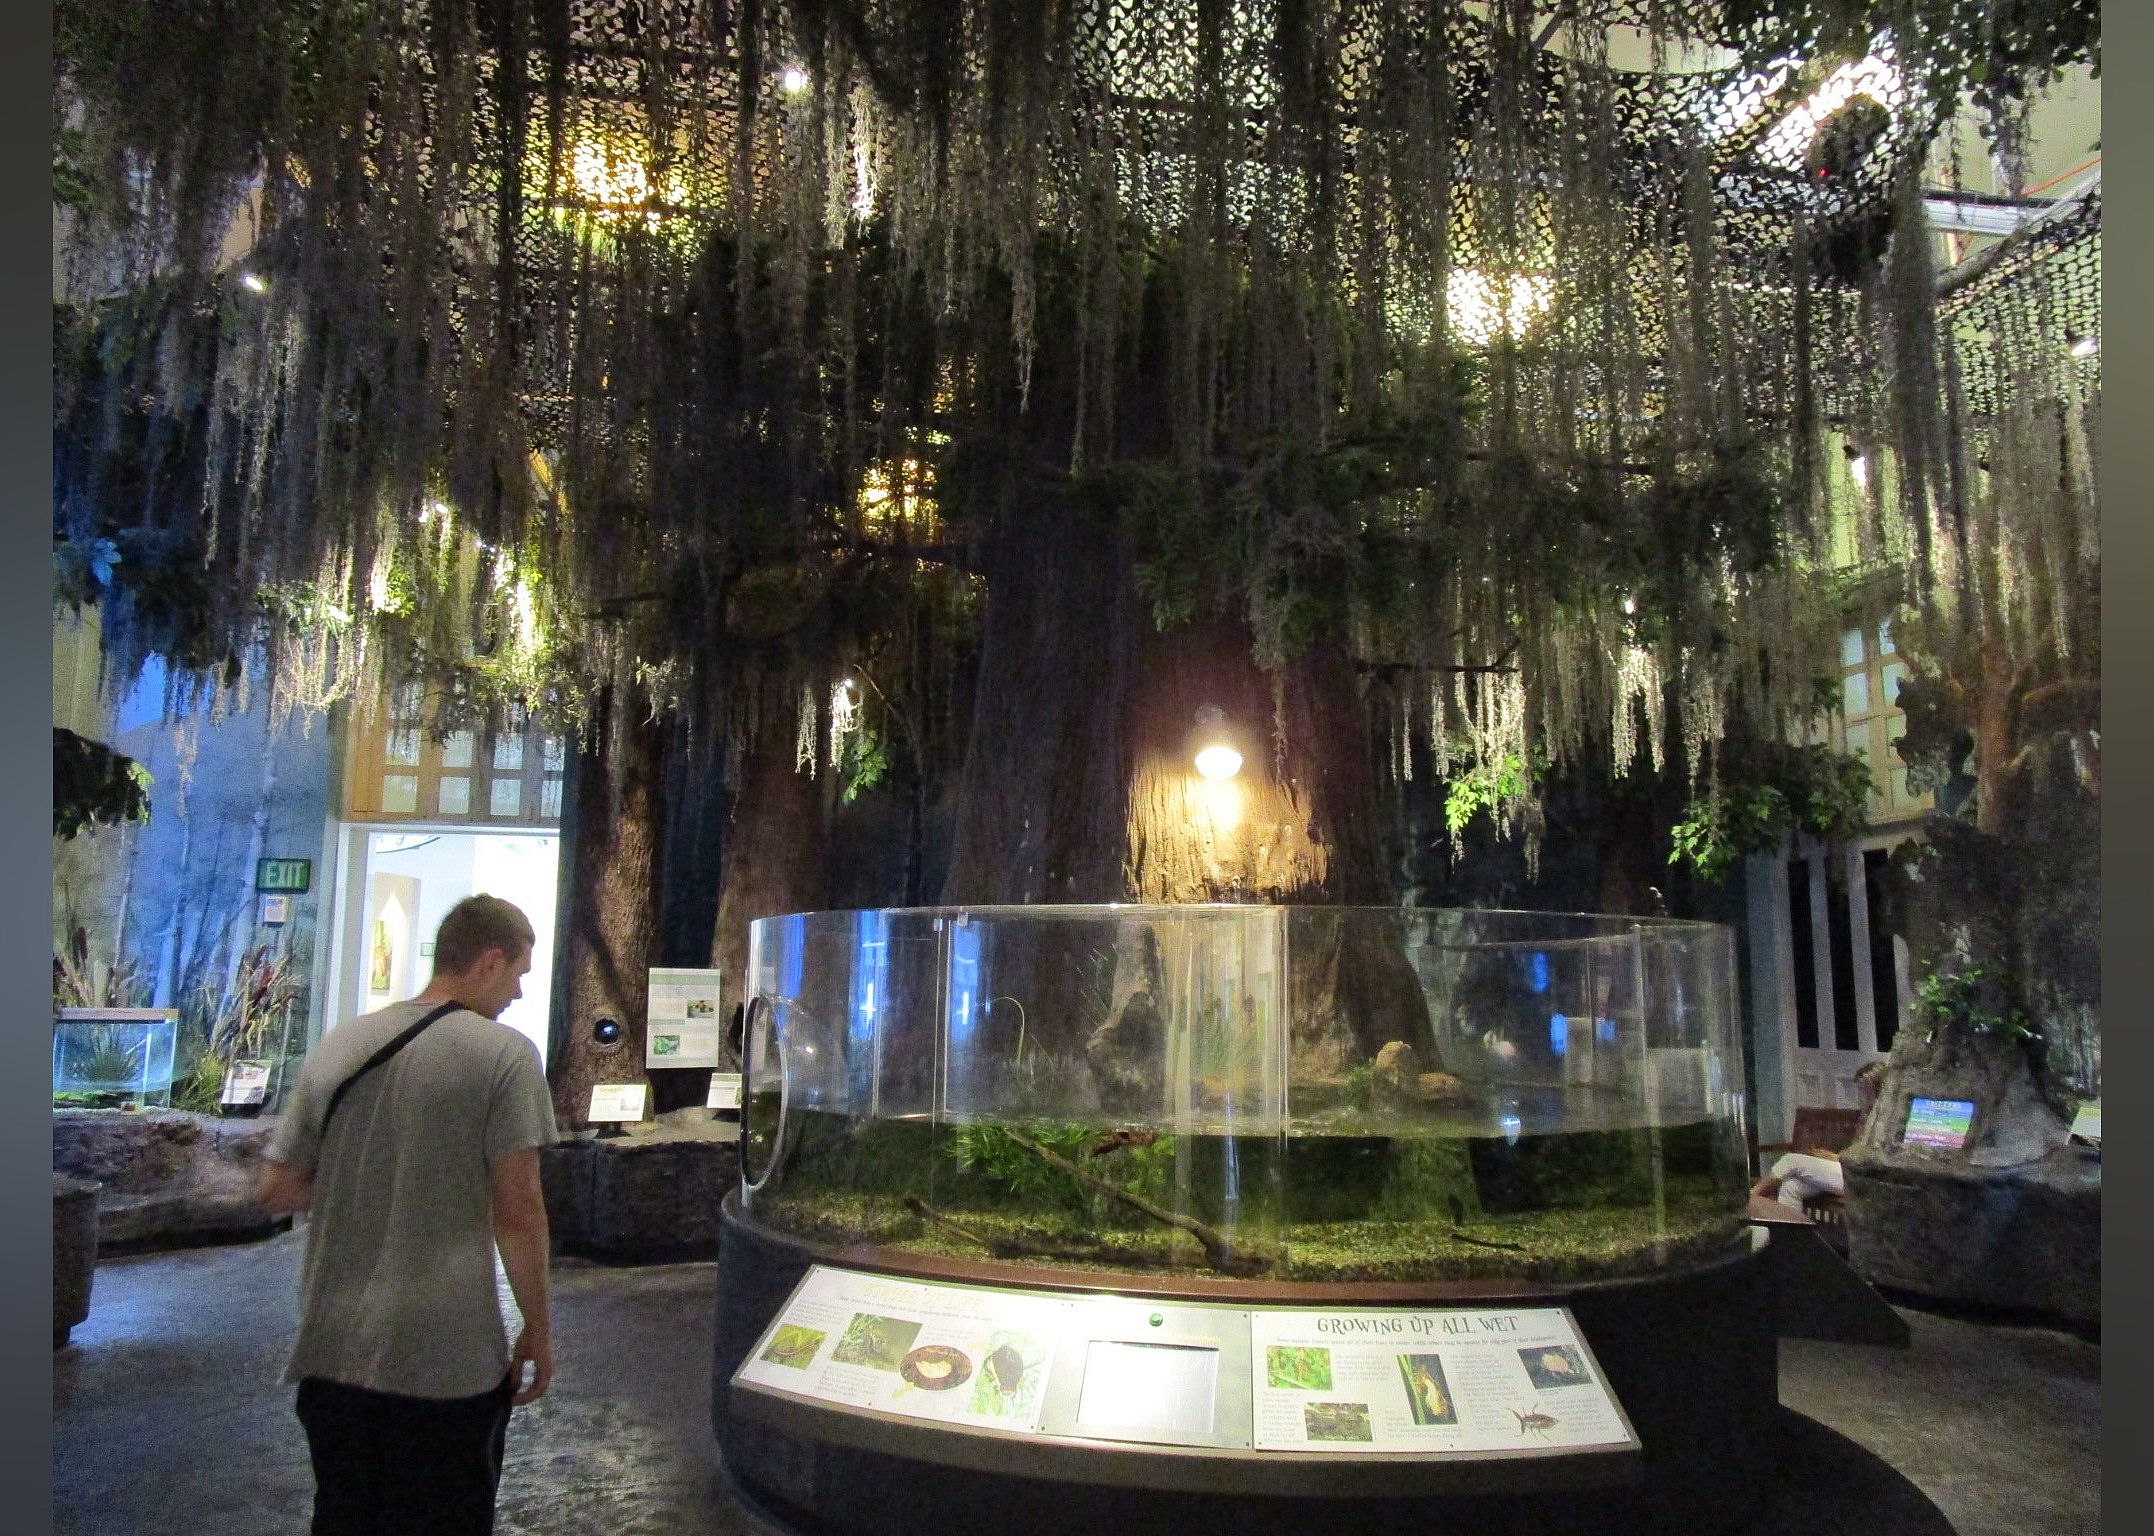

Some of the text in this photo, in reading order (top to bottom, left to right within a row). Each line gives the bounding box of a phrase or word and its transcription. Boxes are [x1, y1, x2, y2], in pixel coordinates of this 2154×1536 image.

[266, 861, 304, 888] EXIT
[1317, 1315, 1518, 1335] GROWING UP ALL WET
